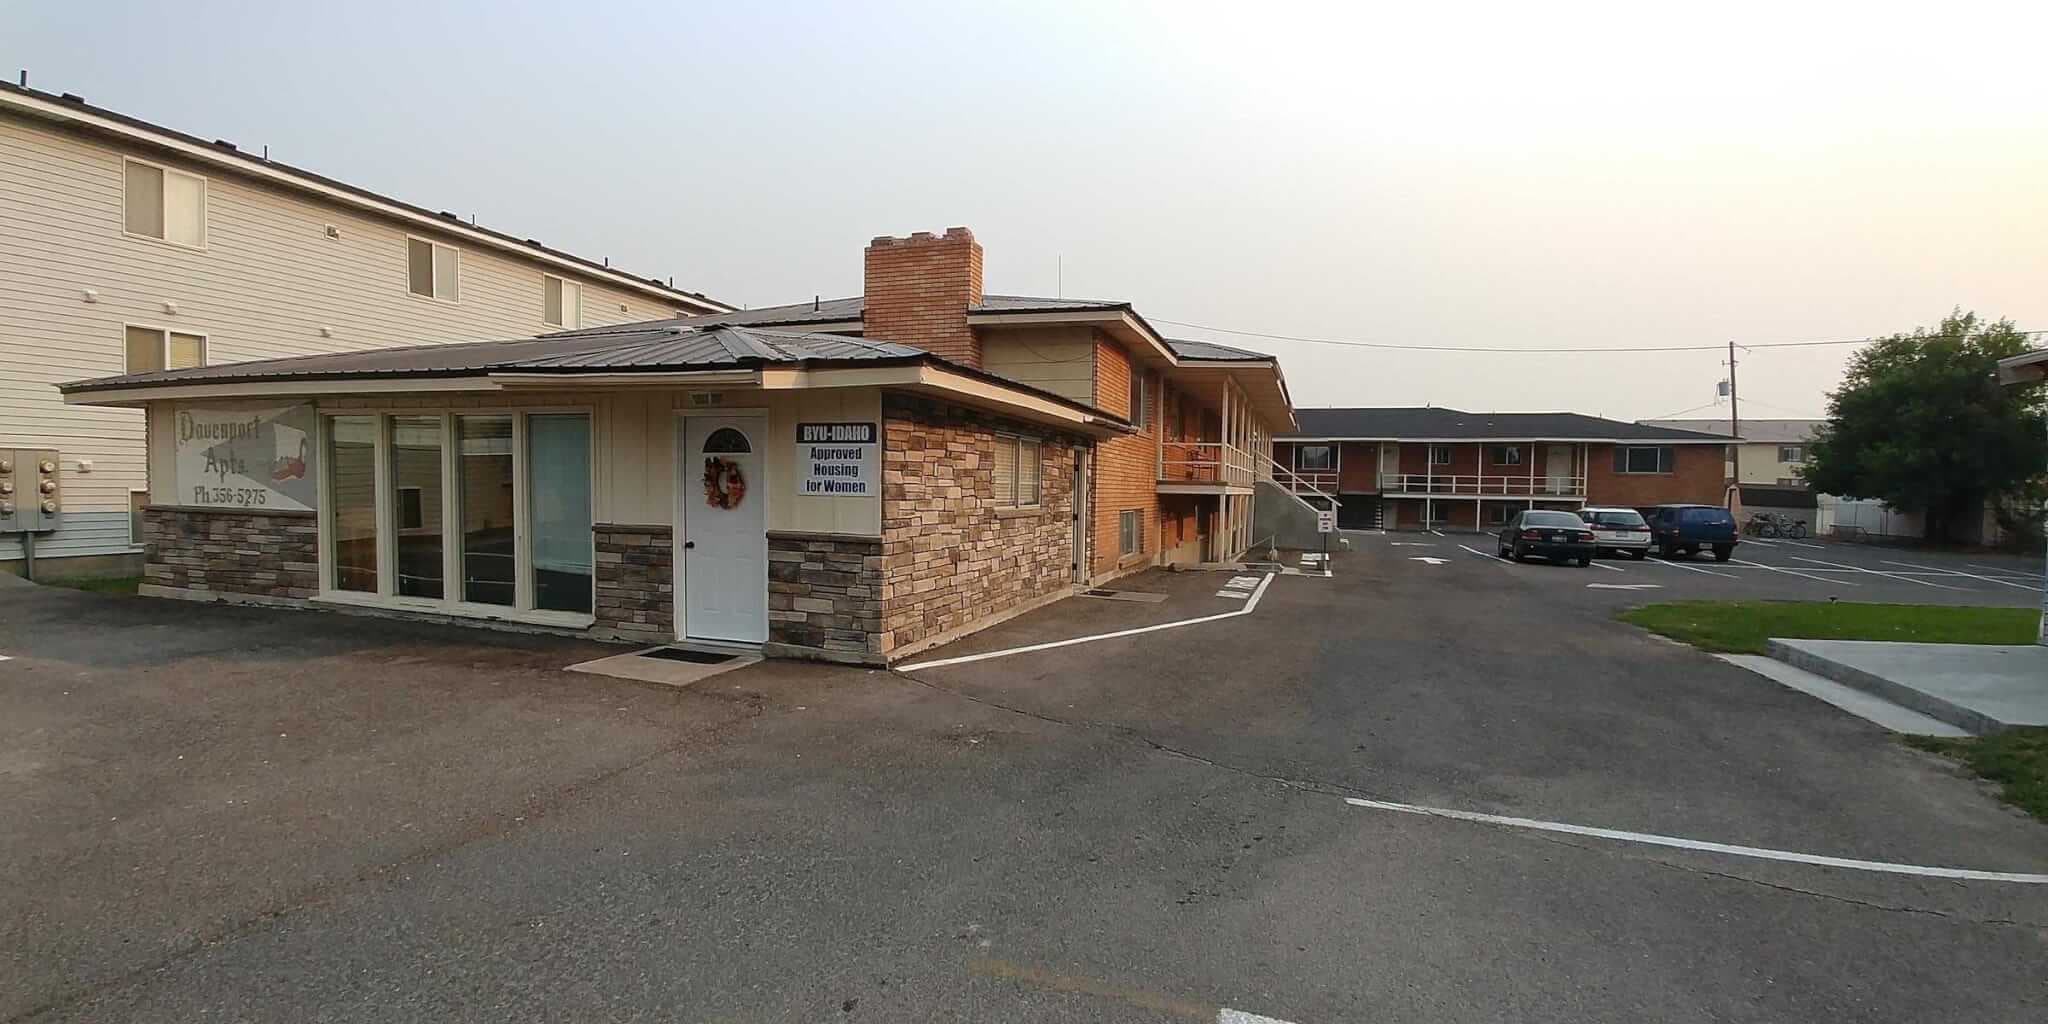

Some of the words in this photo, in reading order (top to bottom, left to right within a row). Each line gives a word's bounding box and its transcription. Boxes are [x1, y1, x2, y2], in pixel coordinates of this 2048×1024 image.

[180, 411, 261, 445] Davenport
[804, 425, 869, 441] BYU-IDAHO
[810, 447, 862, 460] Approved
[814, 463, 859, 477] Housing
[806, 480, 821, 492] for
[824, 480, 866, 492] Women
